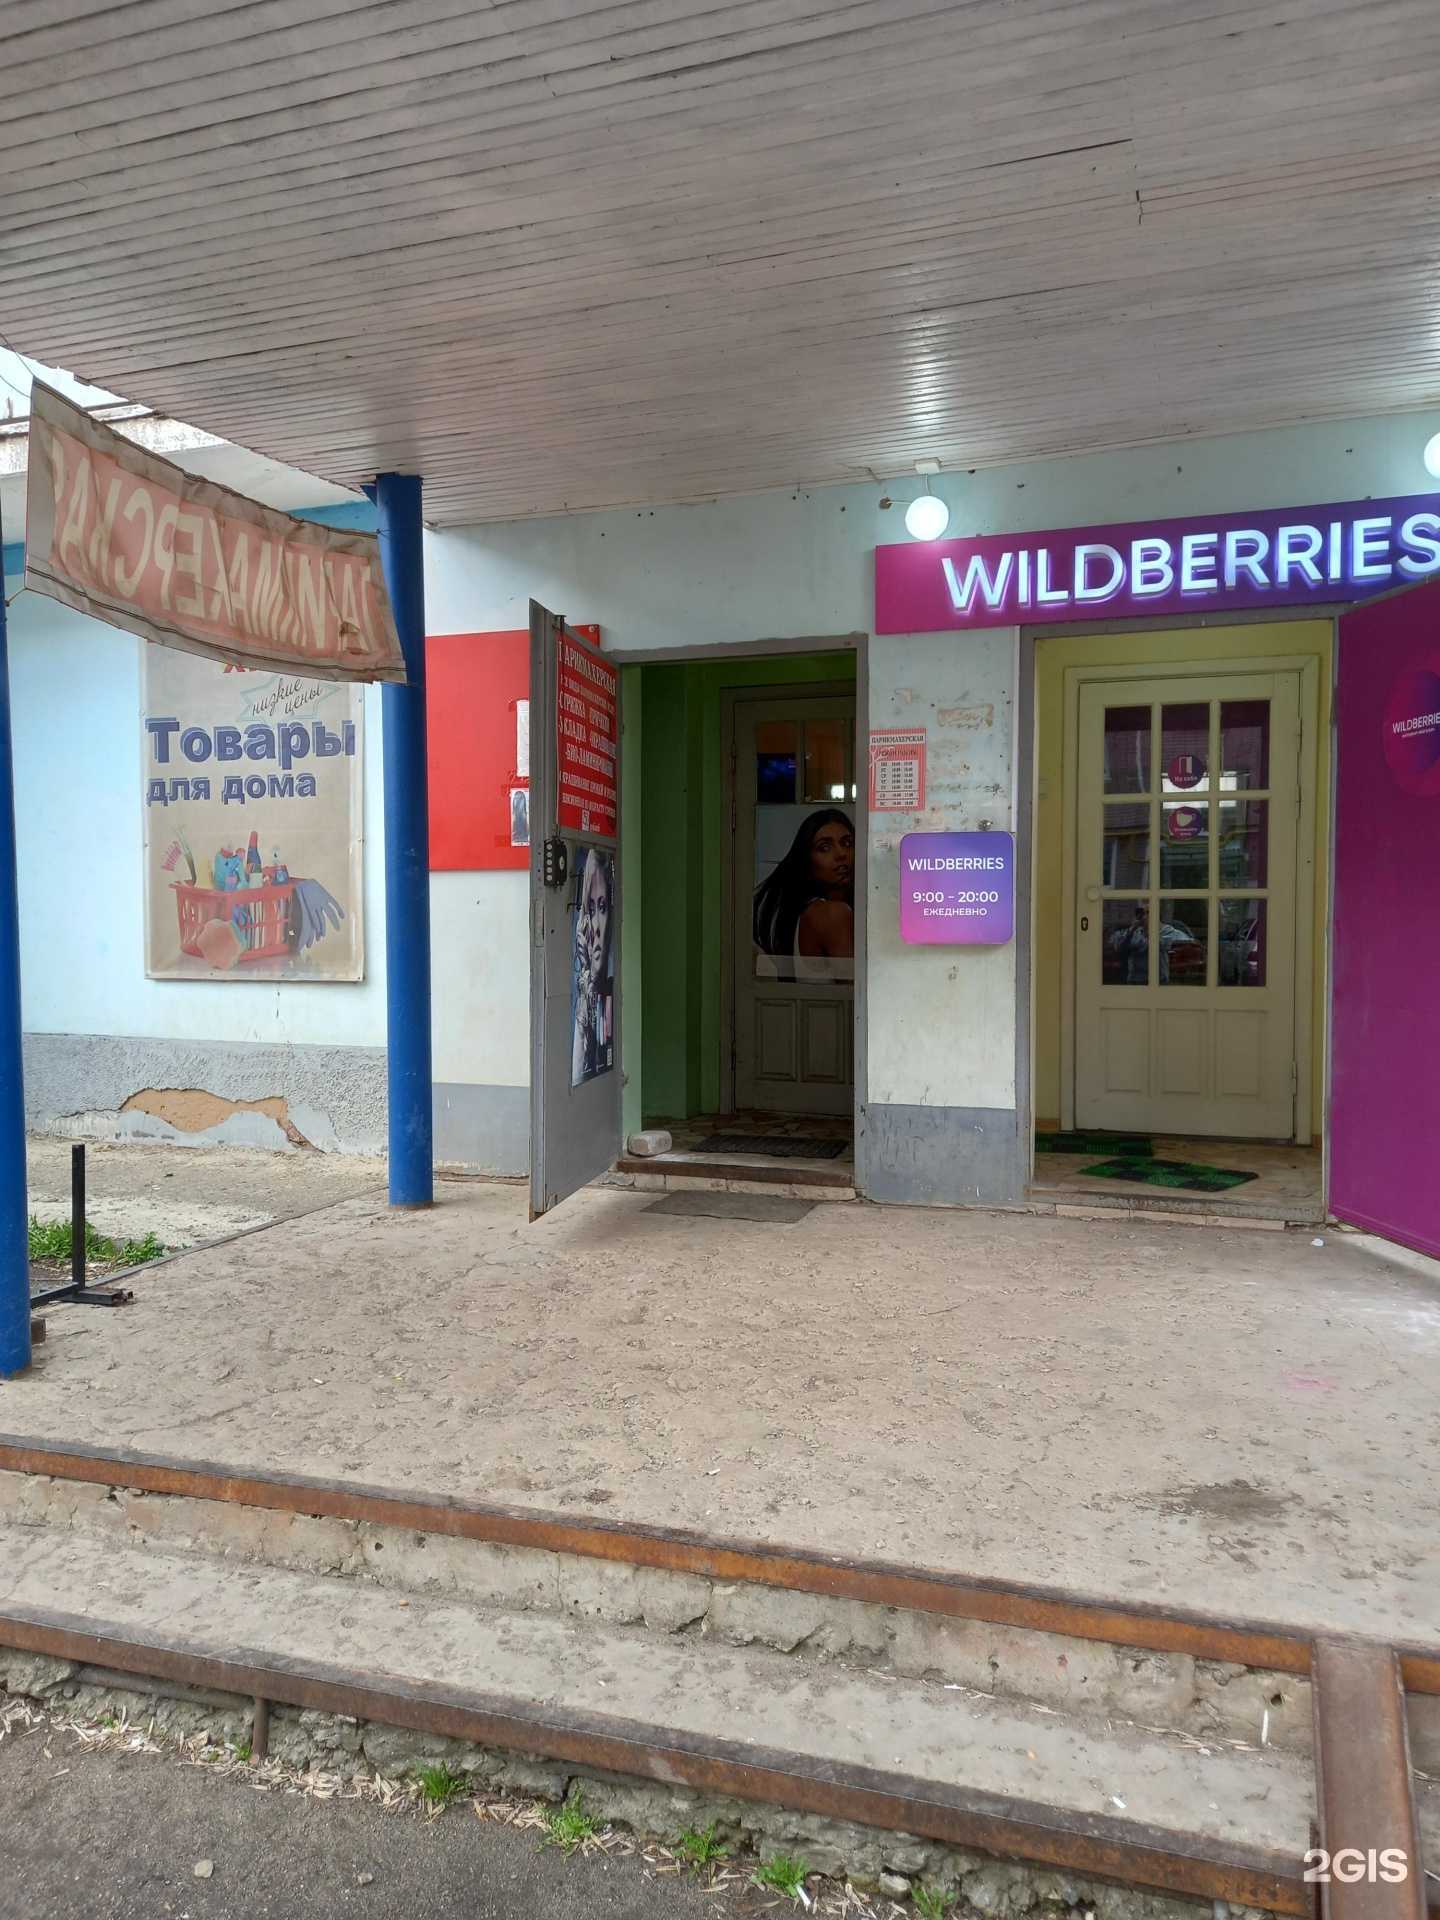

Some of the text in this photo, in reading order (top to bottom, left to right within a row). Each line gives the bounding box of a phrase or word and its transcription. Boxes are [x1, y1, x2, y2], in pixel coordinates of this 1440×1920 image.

[941, 512, 1440, 613] WILDBERRIES
[253, 678, 302, 716] низкие
[285, 683, 321, 715] цены
[145, 717, 355, 770] Товары
[146, 773, 317, 807] для дома
[908, 857, 1004, 871] WILDBERRIES
[912, 891, 944, 903] 9:00
[957, 891, 999, 903] 20:00
[923, 907, 988, 916] ЕЖЕДНЕВНО
